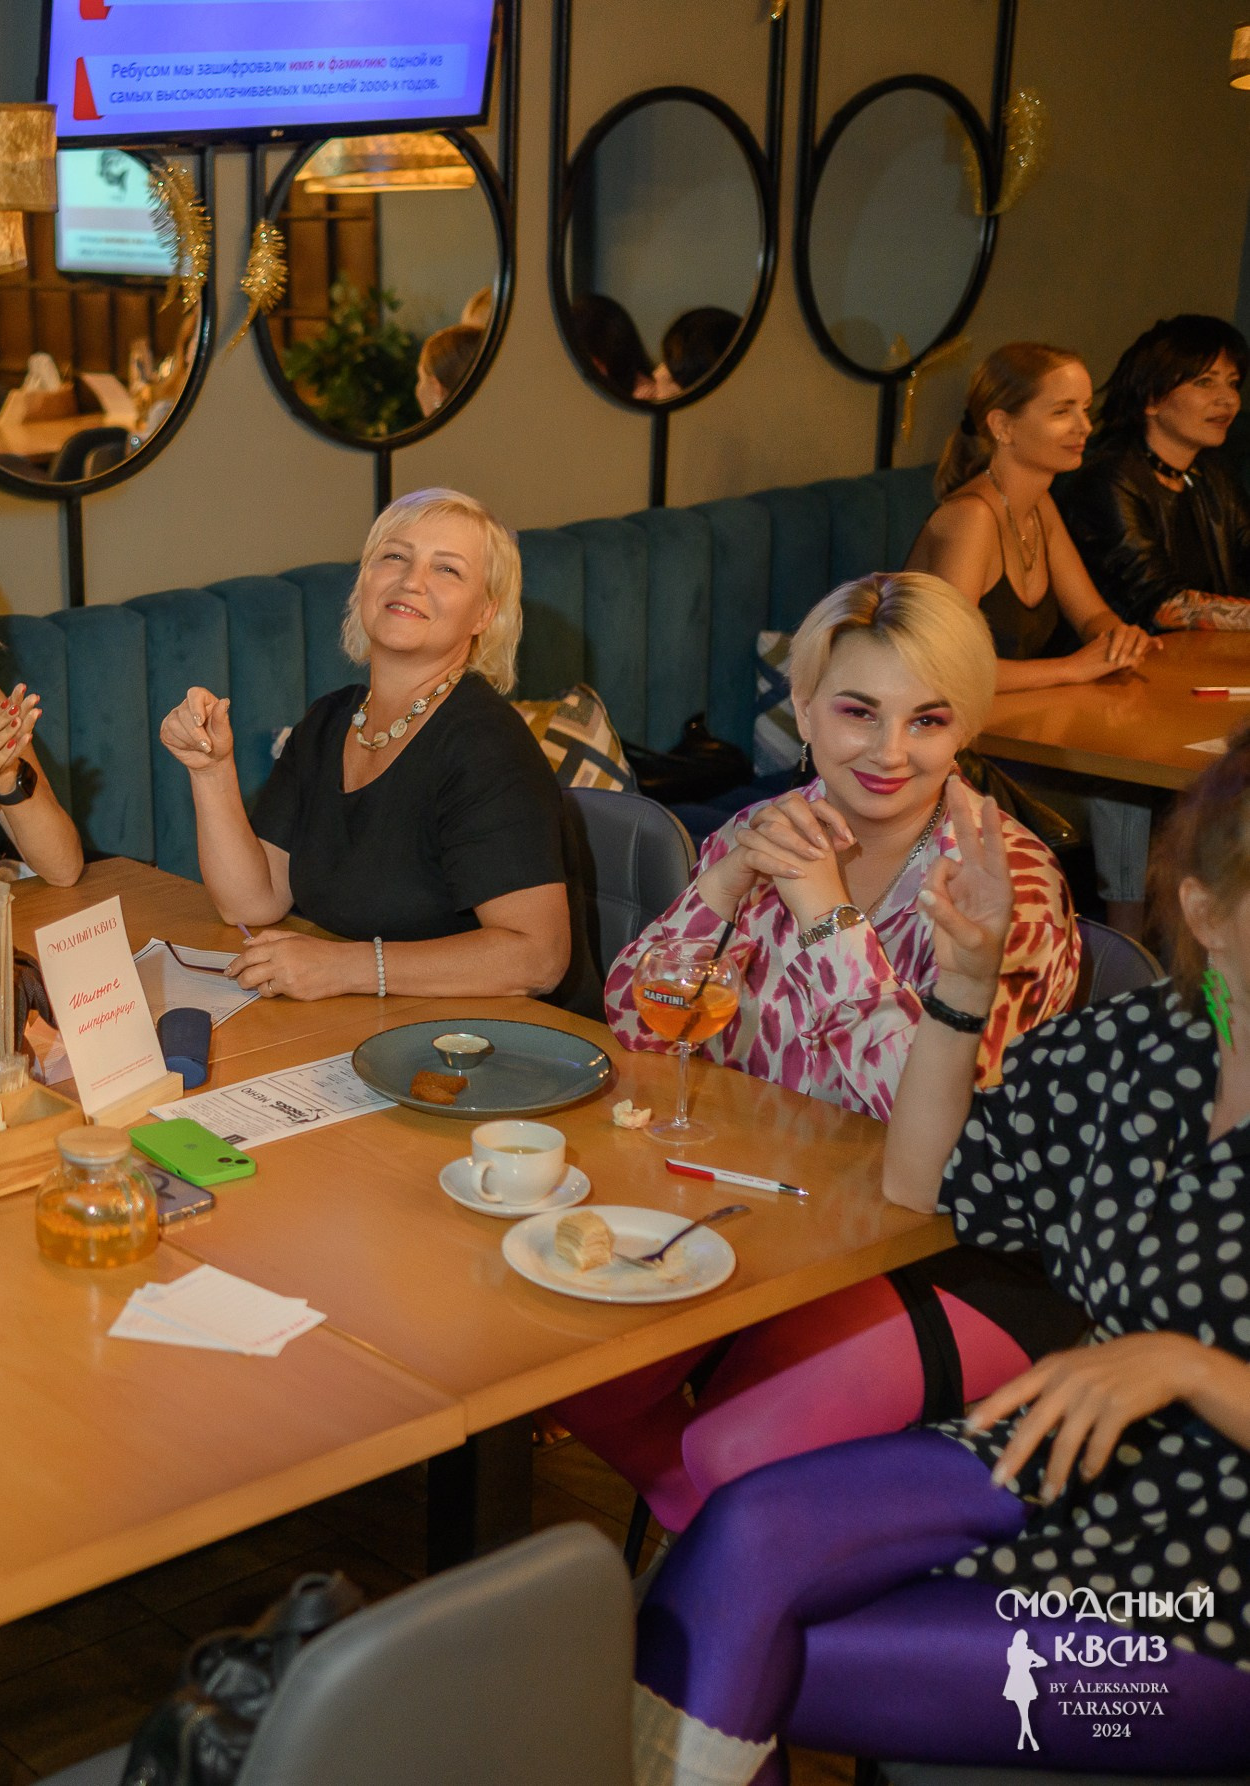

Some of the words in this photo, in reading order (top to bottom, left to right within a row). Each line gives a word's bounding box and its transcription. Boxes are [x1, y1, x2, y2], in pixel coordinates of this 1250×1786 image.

[111, 61, 170, 82] Ребусом
[173, 63, 194, 76] мы
[197, 59, 287, 79] зашифровали
[289, 60, 314, 71] имя
[317, 61, 325, 70] и
[328, 56, 387, 74] фамилию
[389, 52, 428, 71] одной
[429, 54, 443, 67] из
[110, 90, 153, 104] самых
[156, 84, 299, 101] высокооплачиваемых
[302, 78, 358, 97] моделей
[360, 79, 399, 93] 2000-х
[401, 78, 440, 92] годов.
[47, 926, 93, 958] МОДНЫЙ
[94, 917, 117, 936] КВИЗ
[643, 988, 684, 1005] MARTINI
[241, 1087, 271, 1103] МЕНЮ
